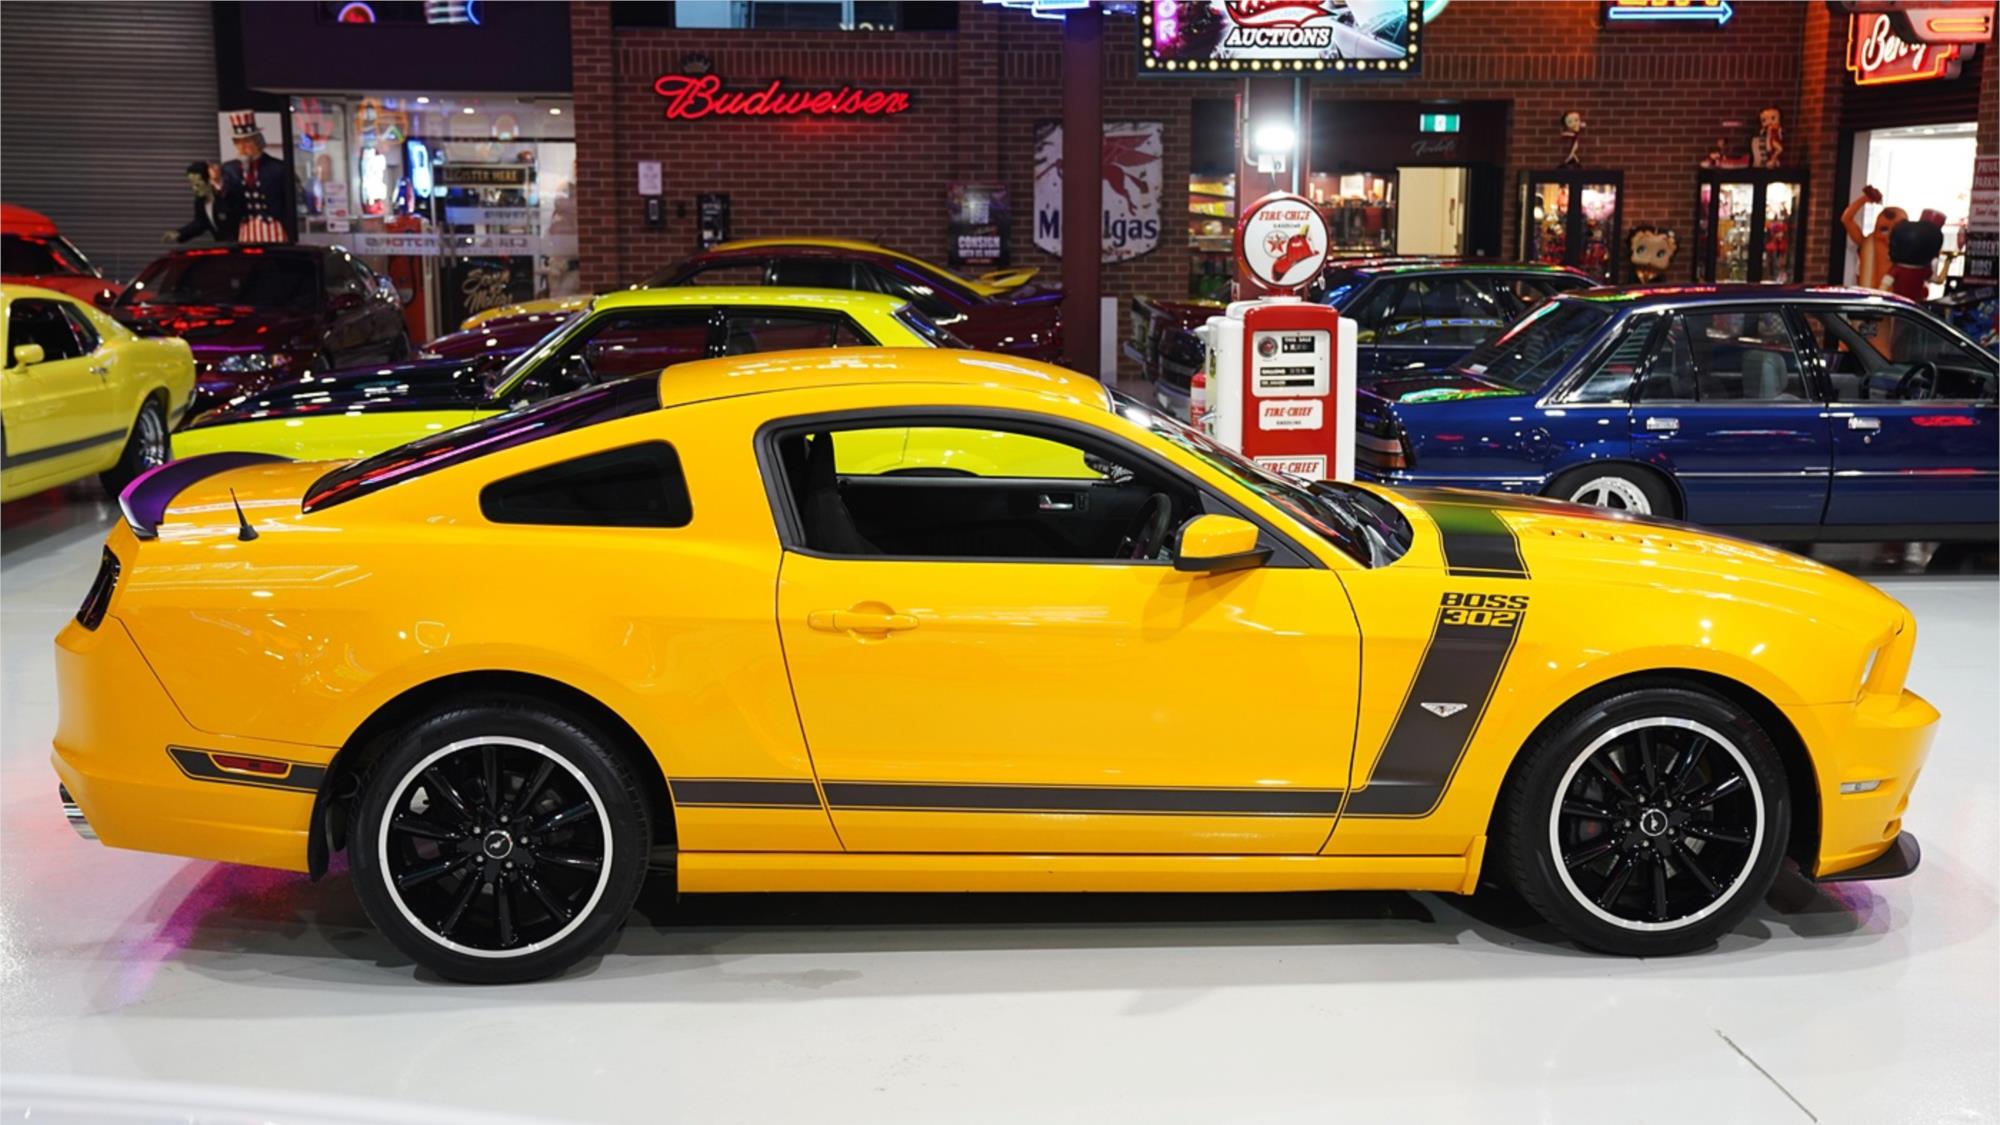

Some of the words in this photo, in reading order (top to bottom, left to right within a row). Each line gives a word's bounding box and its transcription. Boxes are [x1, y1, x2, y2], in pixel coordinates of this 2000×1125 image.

[1227, 27, 1330, 46] AUCTIONS
[654, 75, 909, 119] Budweiser
[1039, 209, 1158, 248] Mlgas
[1264, 407, 1313, 416] FIRE-CHIEF
[1441, 592, 1529, 609] BOSS
[1443, 610, 1516, 627] 302
